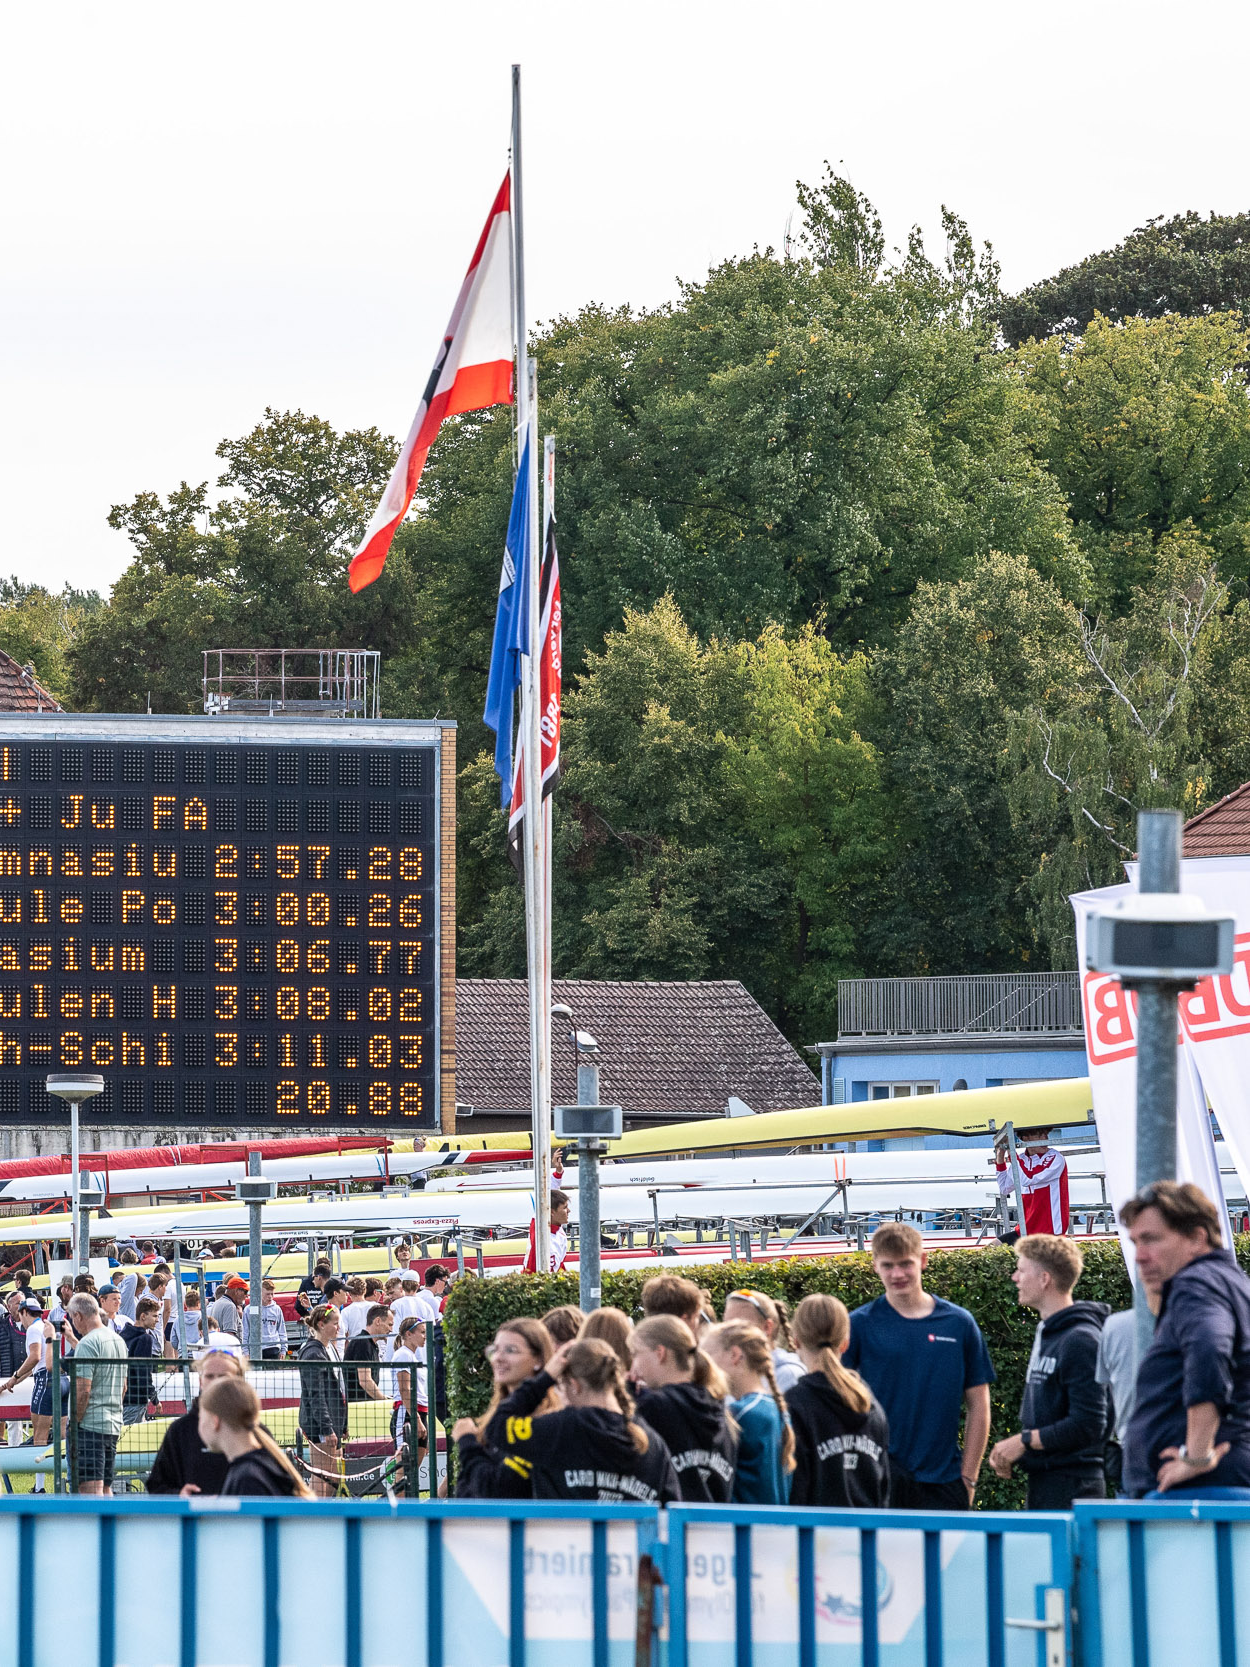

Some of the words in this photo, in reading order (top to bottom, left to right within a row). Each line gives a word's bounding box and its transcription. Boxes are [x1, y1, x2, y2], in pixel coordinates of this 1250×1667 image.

[60, 794, 115, 829] Ju
[153, 796, 208, 831] FA
[215, 844, 423, 881] 2:57.28
[122, 890, 176, 924] Po
[214, 891, 422, 928] 3:00.26
[214, 938, 422, 975] 3:06.77
[152, 984, 176, 1019] H
[214, 985, 422, 1022] 3:08.02
[214, 1032, 423, 1069] 3:11.03
[276, 1081, 423, 1116] 20.88
[412, 1217, 459, 1226] Pizza-Express
